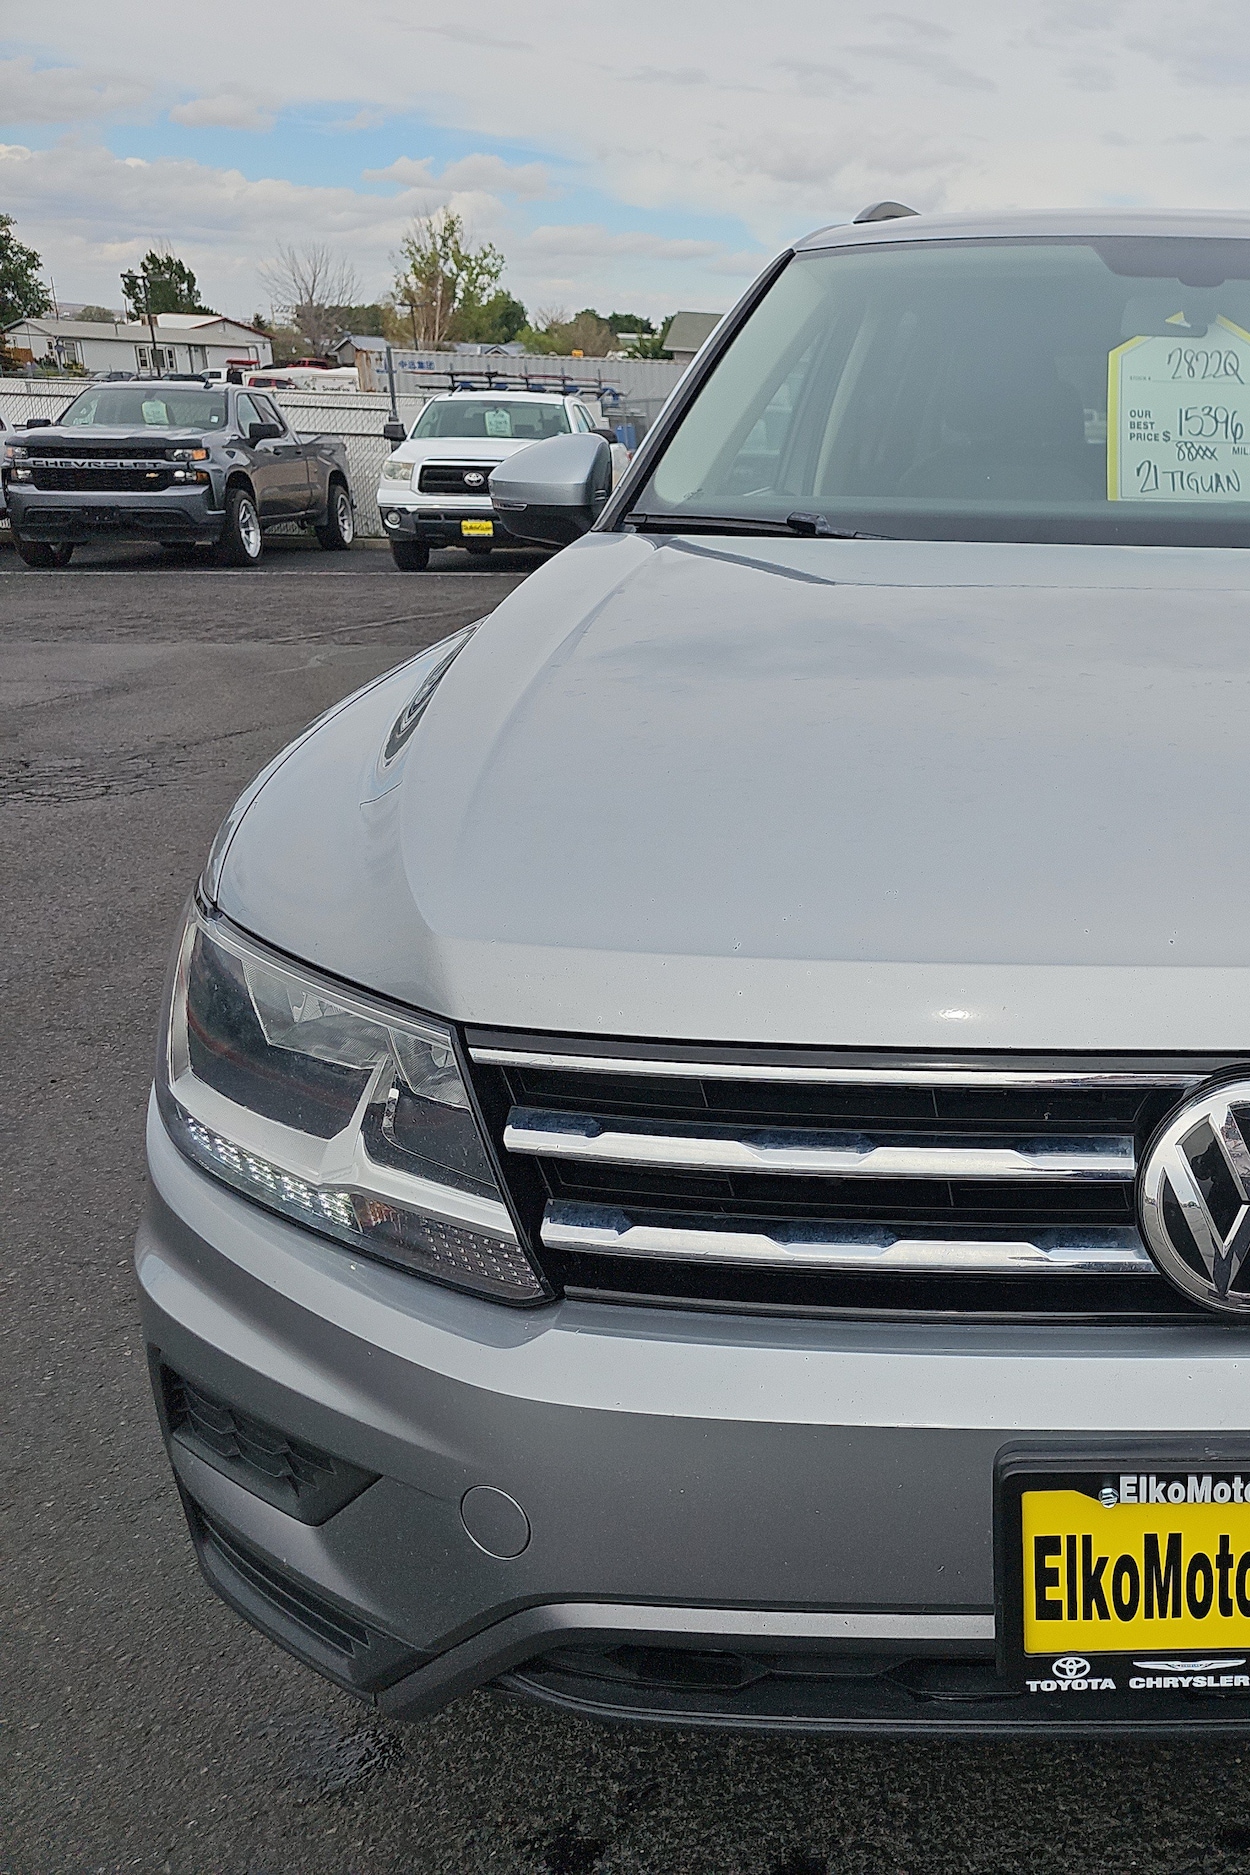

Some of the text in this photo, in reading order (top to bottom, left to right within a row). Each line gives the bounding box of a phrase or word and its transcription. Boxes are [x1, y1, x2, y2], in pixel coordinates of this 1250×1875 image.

[1166, 347, 1245, 385] 2822Q
[1129, 409, 1151, 418] OUR
[1129, 421, 1155, 430] BEST
[1178, 405, 1243, 444] 15396
[1129, 431, 1171, 443] PRICE $
[32, 460, 161, 469] CHEVROLET
[1136, 460, 1241, 494] 21 TIGUAN
[1025, 1678, 1117, 1692] TOYOTA
[1128, 1675, 1250, 1689] CHRYSLER
